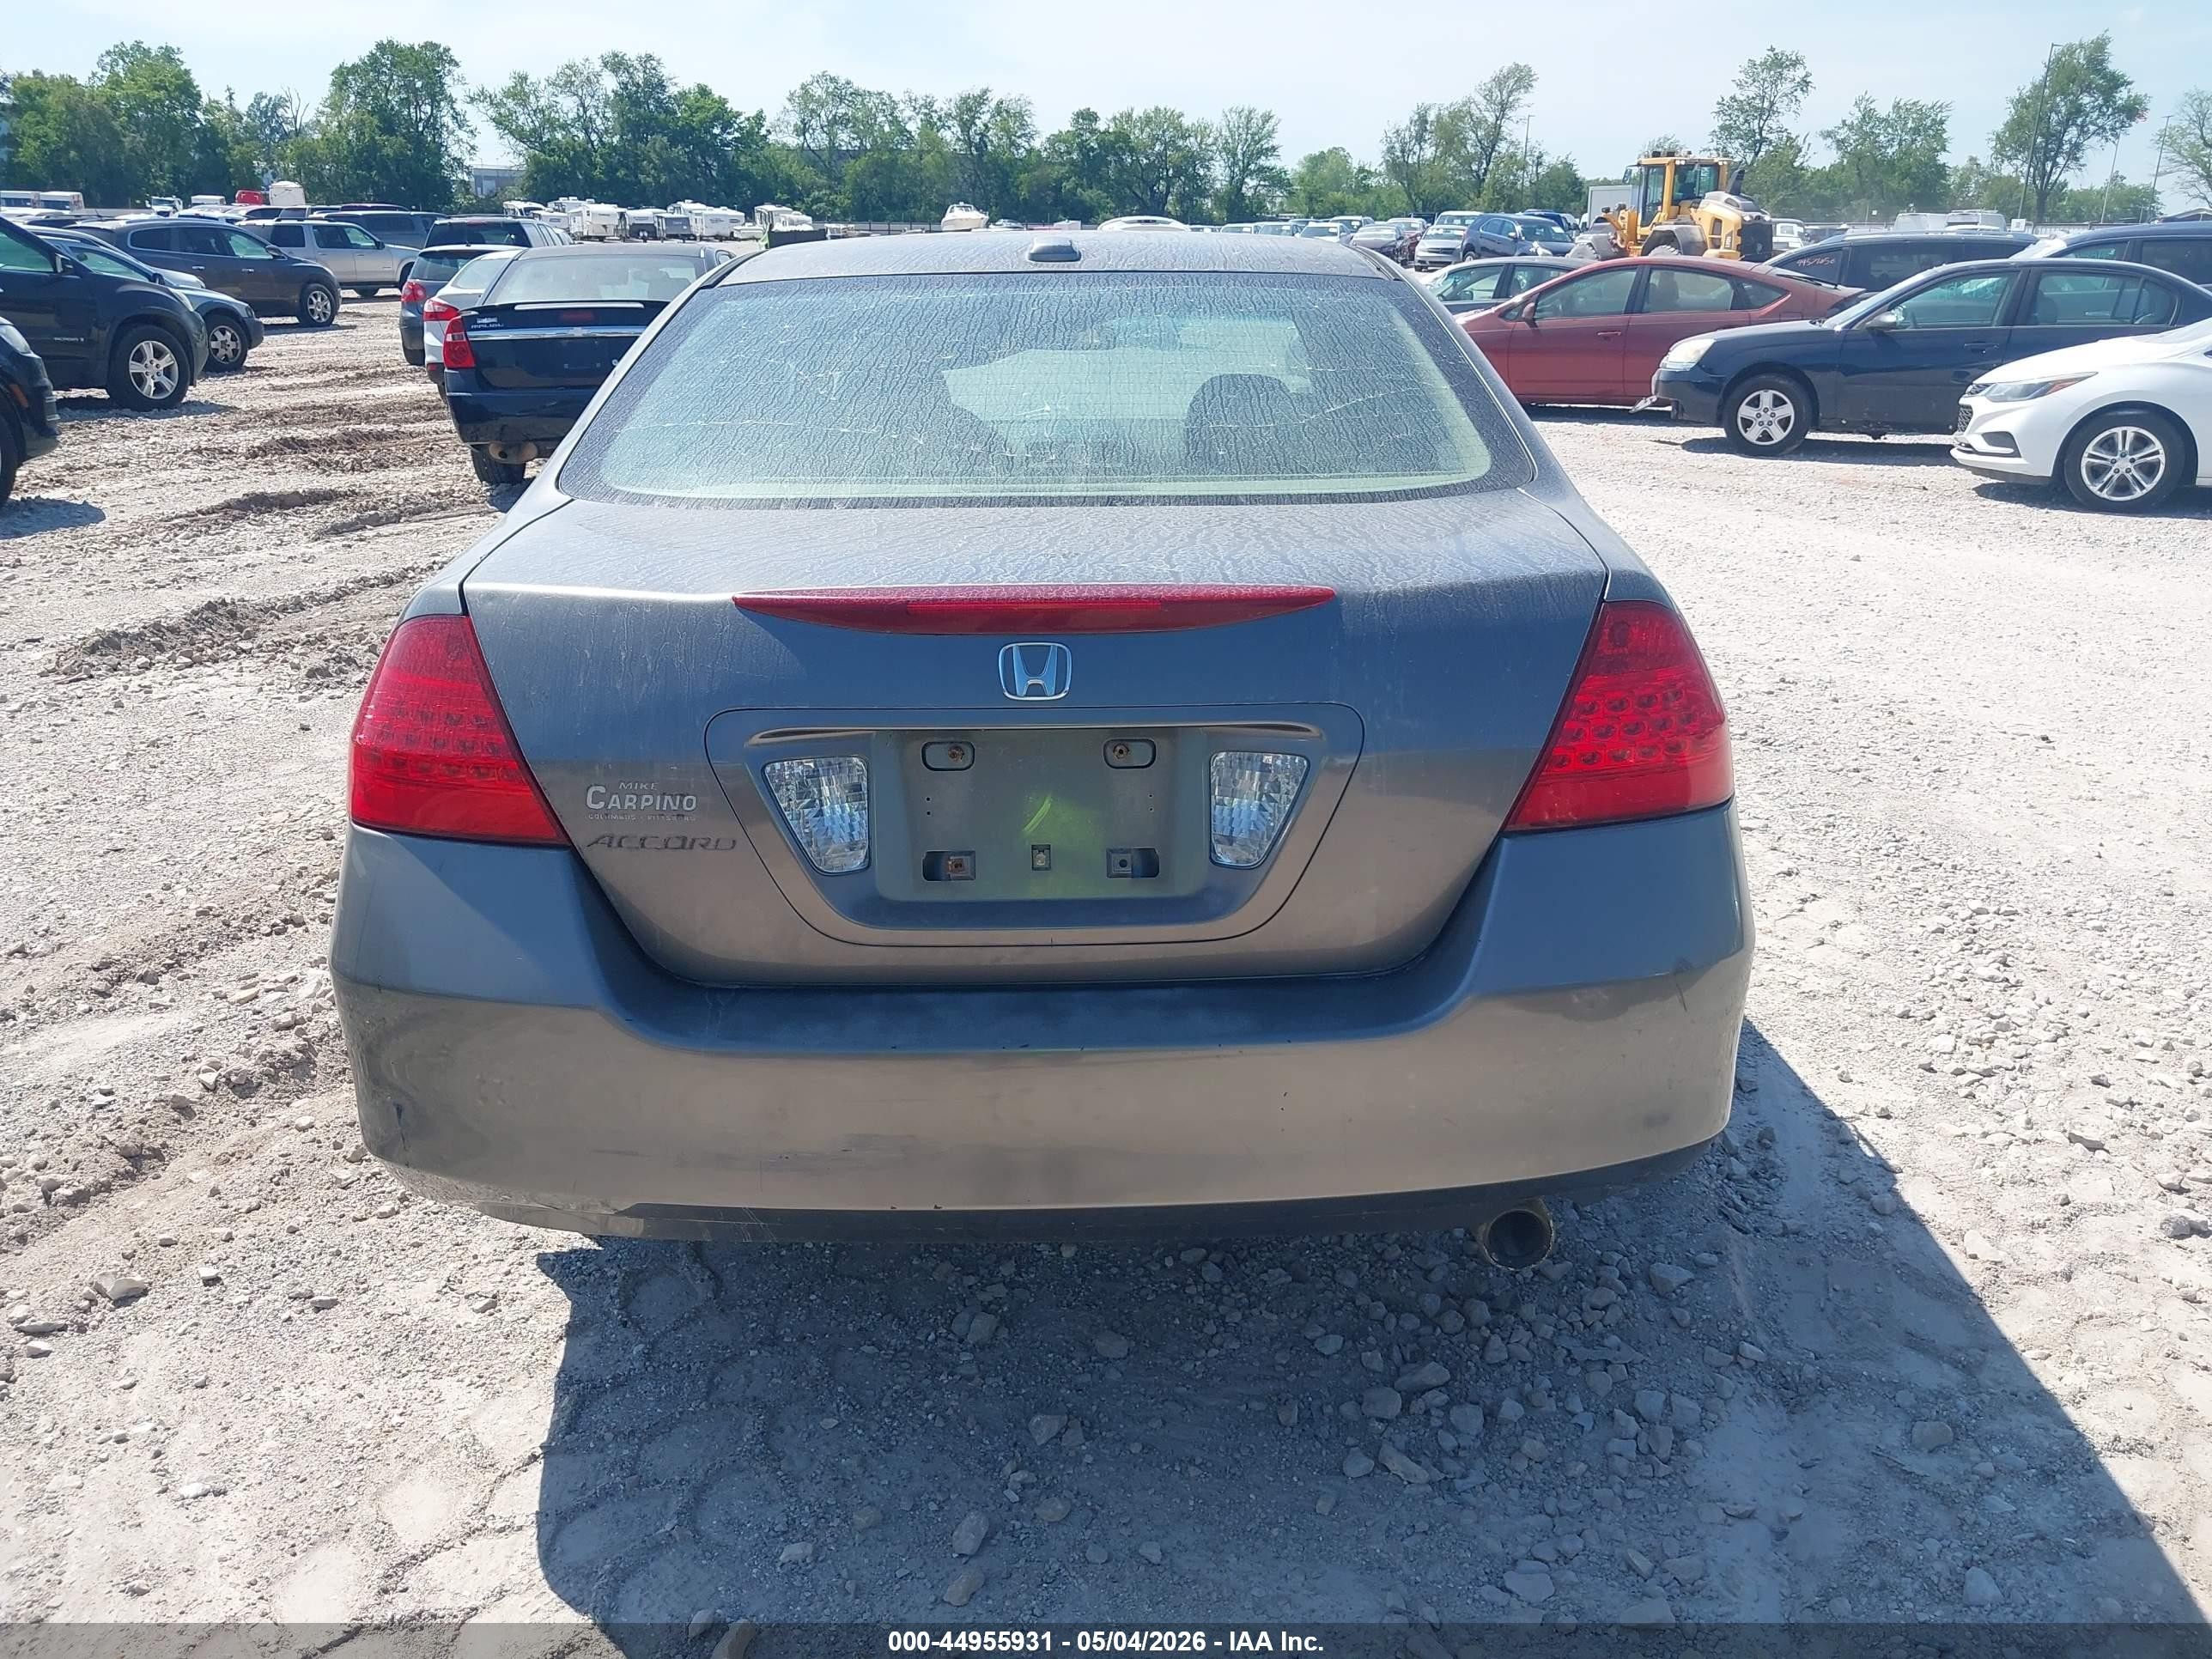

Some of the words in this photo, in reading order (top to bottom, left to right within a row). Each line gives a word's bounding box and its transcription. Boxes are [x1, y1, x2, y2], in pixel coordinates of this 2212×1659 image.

[618, 781, 659, 791] MIKE
[586, 785, 698, 811] CARPINO
[586, 834, 738, 851] ACCORD
